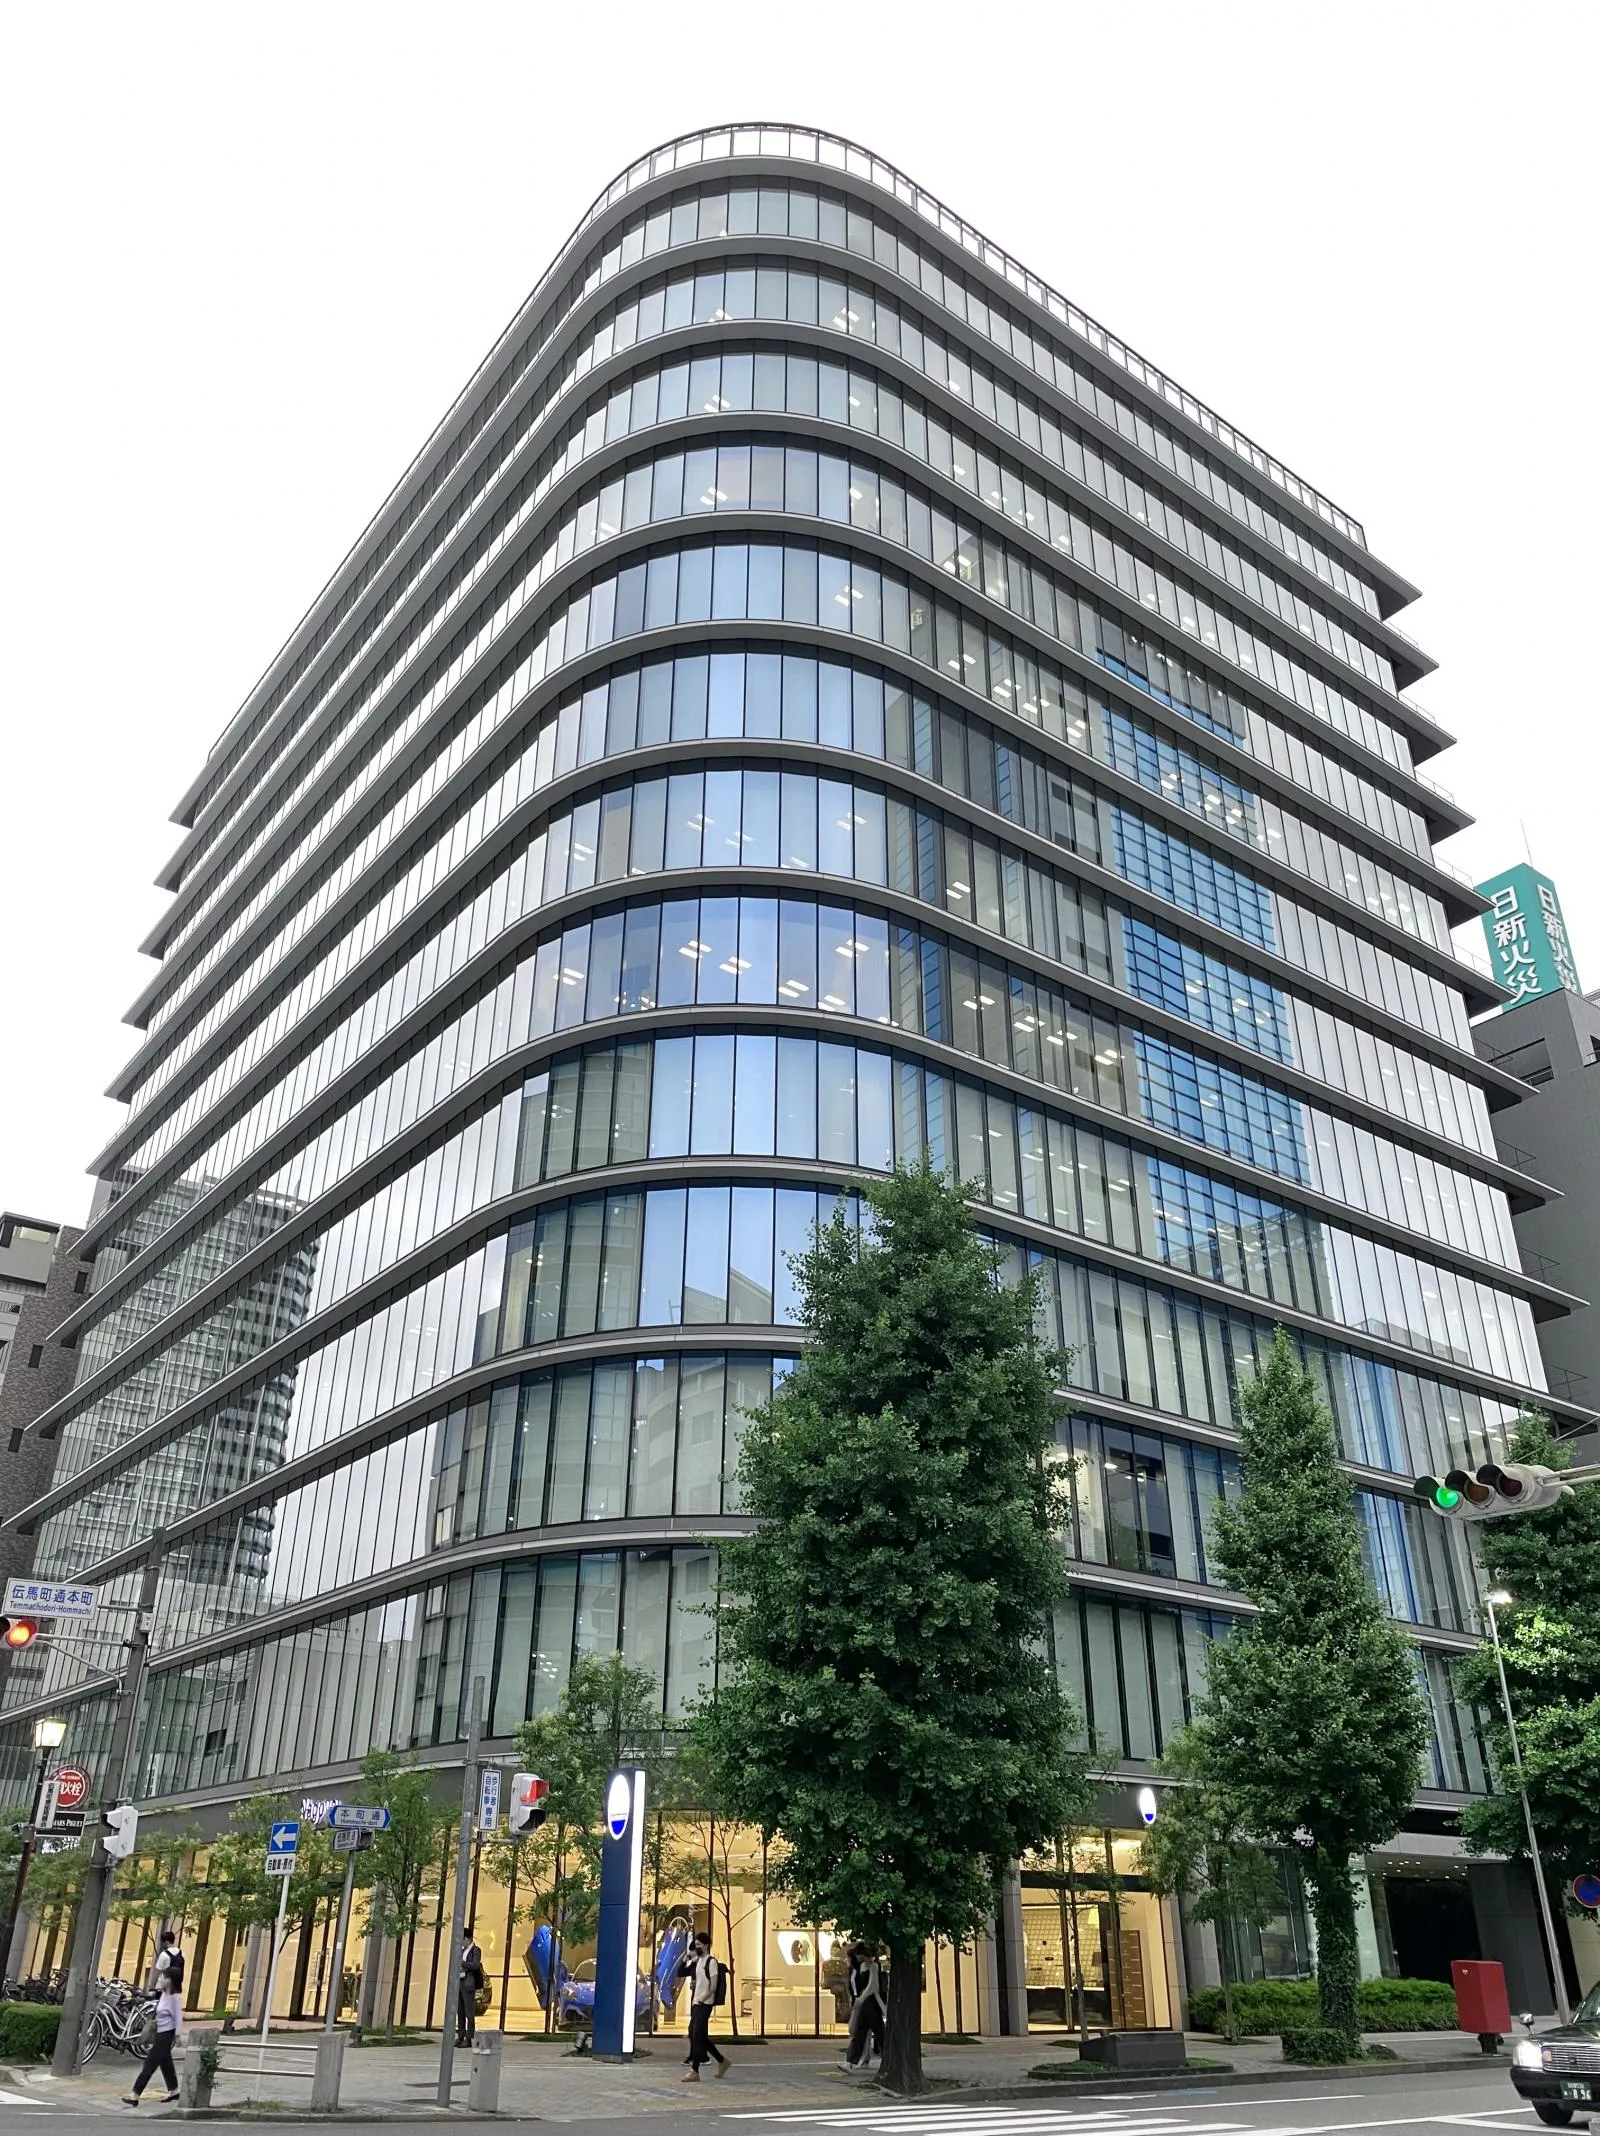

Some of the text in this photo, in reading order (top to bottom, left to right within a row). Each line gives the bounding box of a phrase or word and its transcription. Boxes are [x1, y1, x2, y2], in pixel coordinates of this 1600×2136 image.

[1491, 885, 1543, 1005] 日新火災
[12, 1584, 94, 1606] 伝馬町通本町
